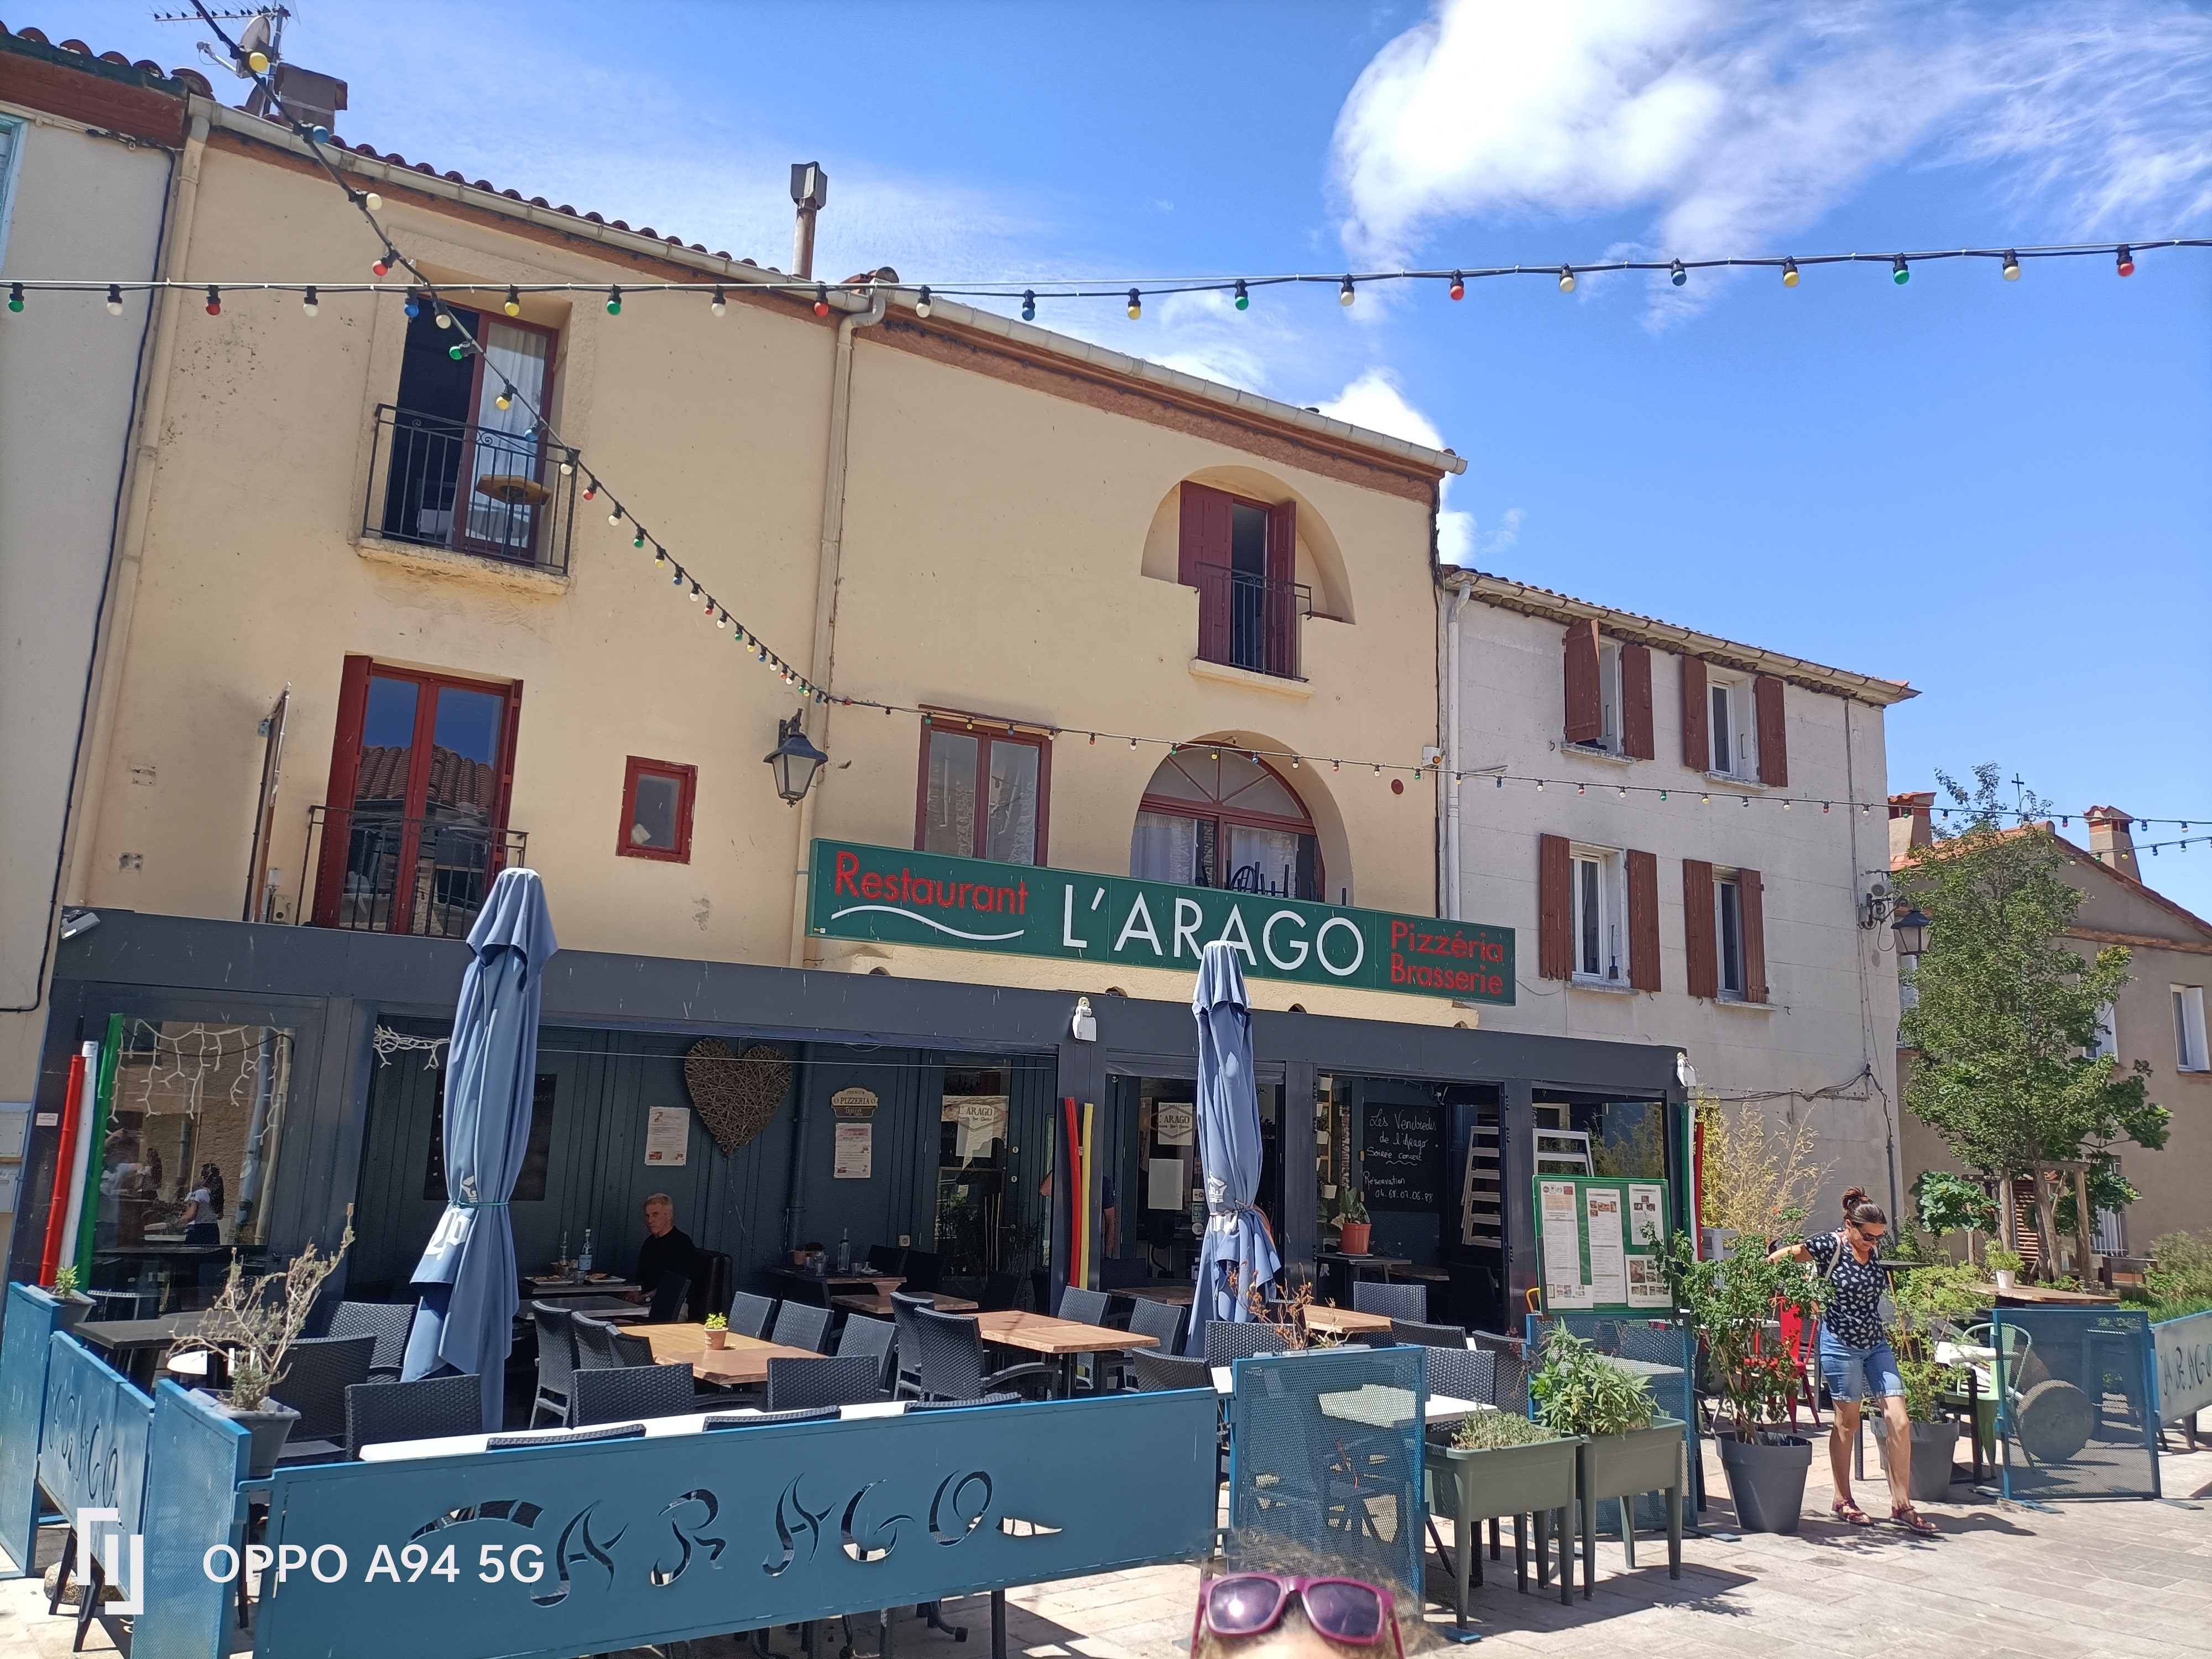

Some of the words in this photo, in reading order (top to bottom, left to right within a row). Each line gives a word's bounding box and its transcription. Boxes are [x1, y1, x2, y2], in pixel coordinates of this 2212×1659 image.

[834, 851, 1029, 915] Restaurant
[1063, 884, 1364, 977] L'ARAGO
[1391, 920, 1503, 962] Pizzéria
[1390, 952, 1503, 995] Brasserie
[1369, 1108, 1389, 1127] Les
[1394, 1109, 1437, 1131] Vendredis
[1380, 1131, 1389, 1144] de
[1363, 1171, 1405, 1190] Réservation
[530, 1469, 993, 1608] ARAGO
